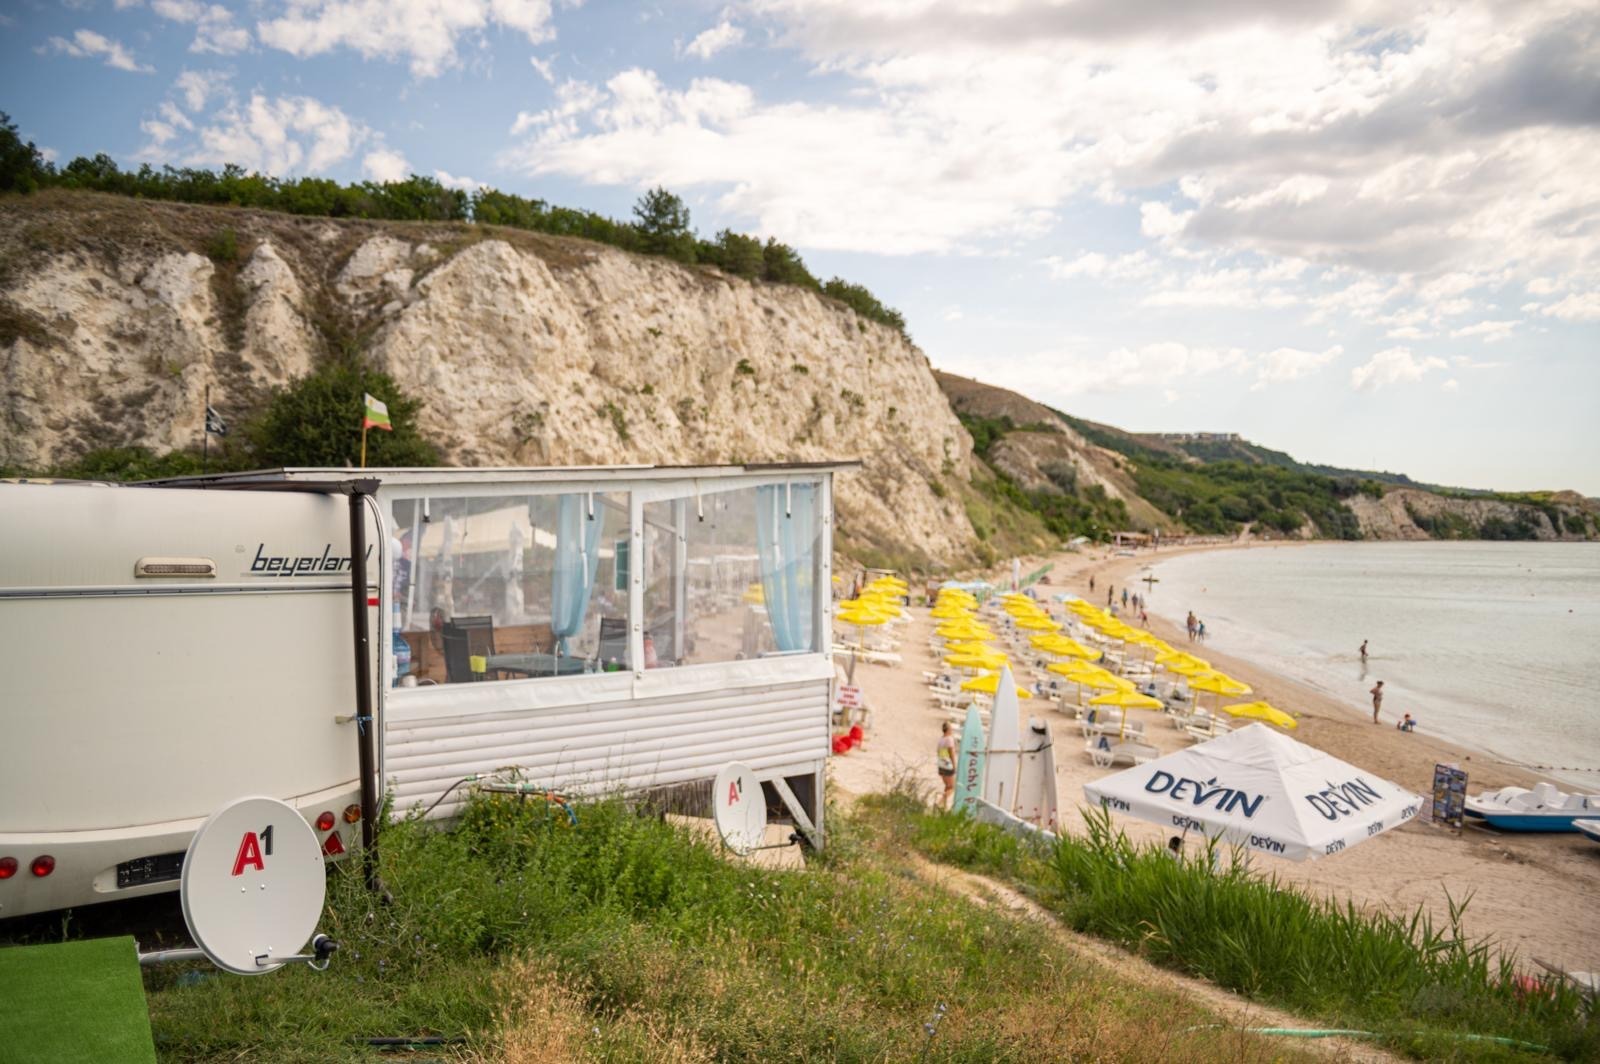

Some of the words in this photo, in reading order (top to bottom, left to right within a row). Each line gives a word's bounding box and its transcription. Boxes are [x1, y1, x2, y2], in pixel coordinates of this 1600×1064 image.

[728, 775, 742, 806] A1
[1144, 770, 1264, 818] DEVIN
[1305, 777, 1383, 820] DEVIN
[1368, 820, 1384, 836] DEVIN
[231, 824, 274, 876] A1
[1251, 834, 1286, 854] DEVIN
[1326, 838, 1346, 855] DEVIN
